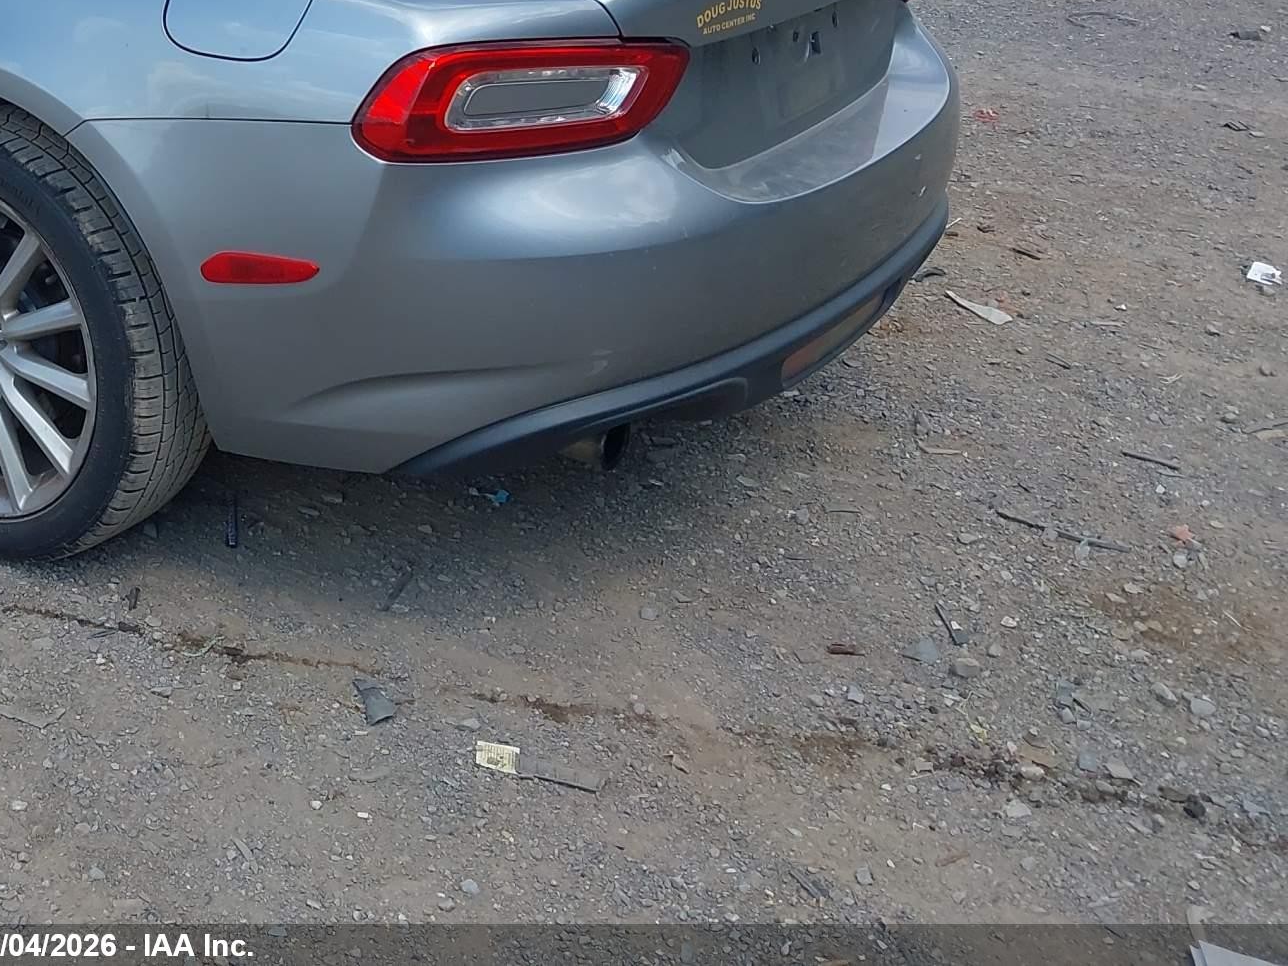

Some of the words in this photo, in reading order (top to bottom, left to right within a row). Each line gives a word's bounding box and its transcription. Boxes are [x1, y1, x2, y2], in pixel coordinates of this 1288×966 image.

[696, 2, 726, 28] DOUG
[703, 24, 721, 35] AUTO
[721, 16, 745, 30] CENTER
[745, 12, 757, 23] INC
